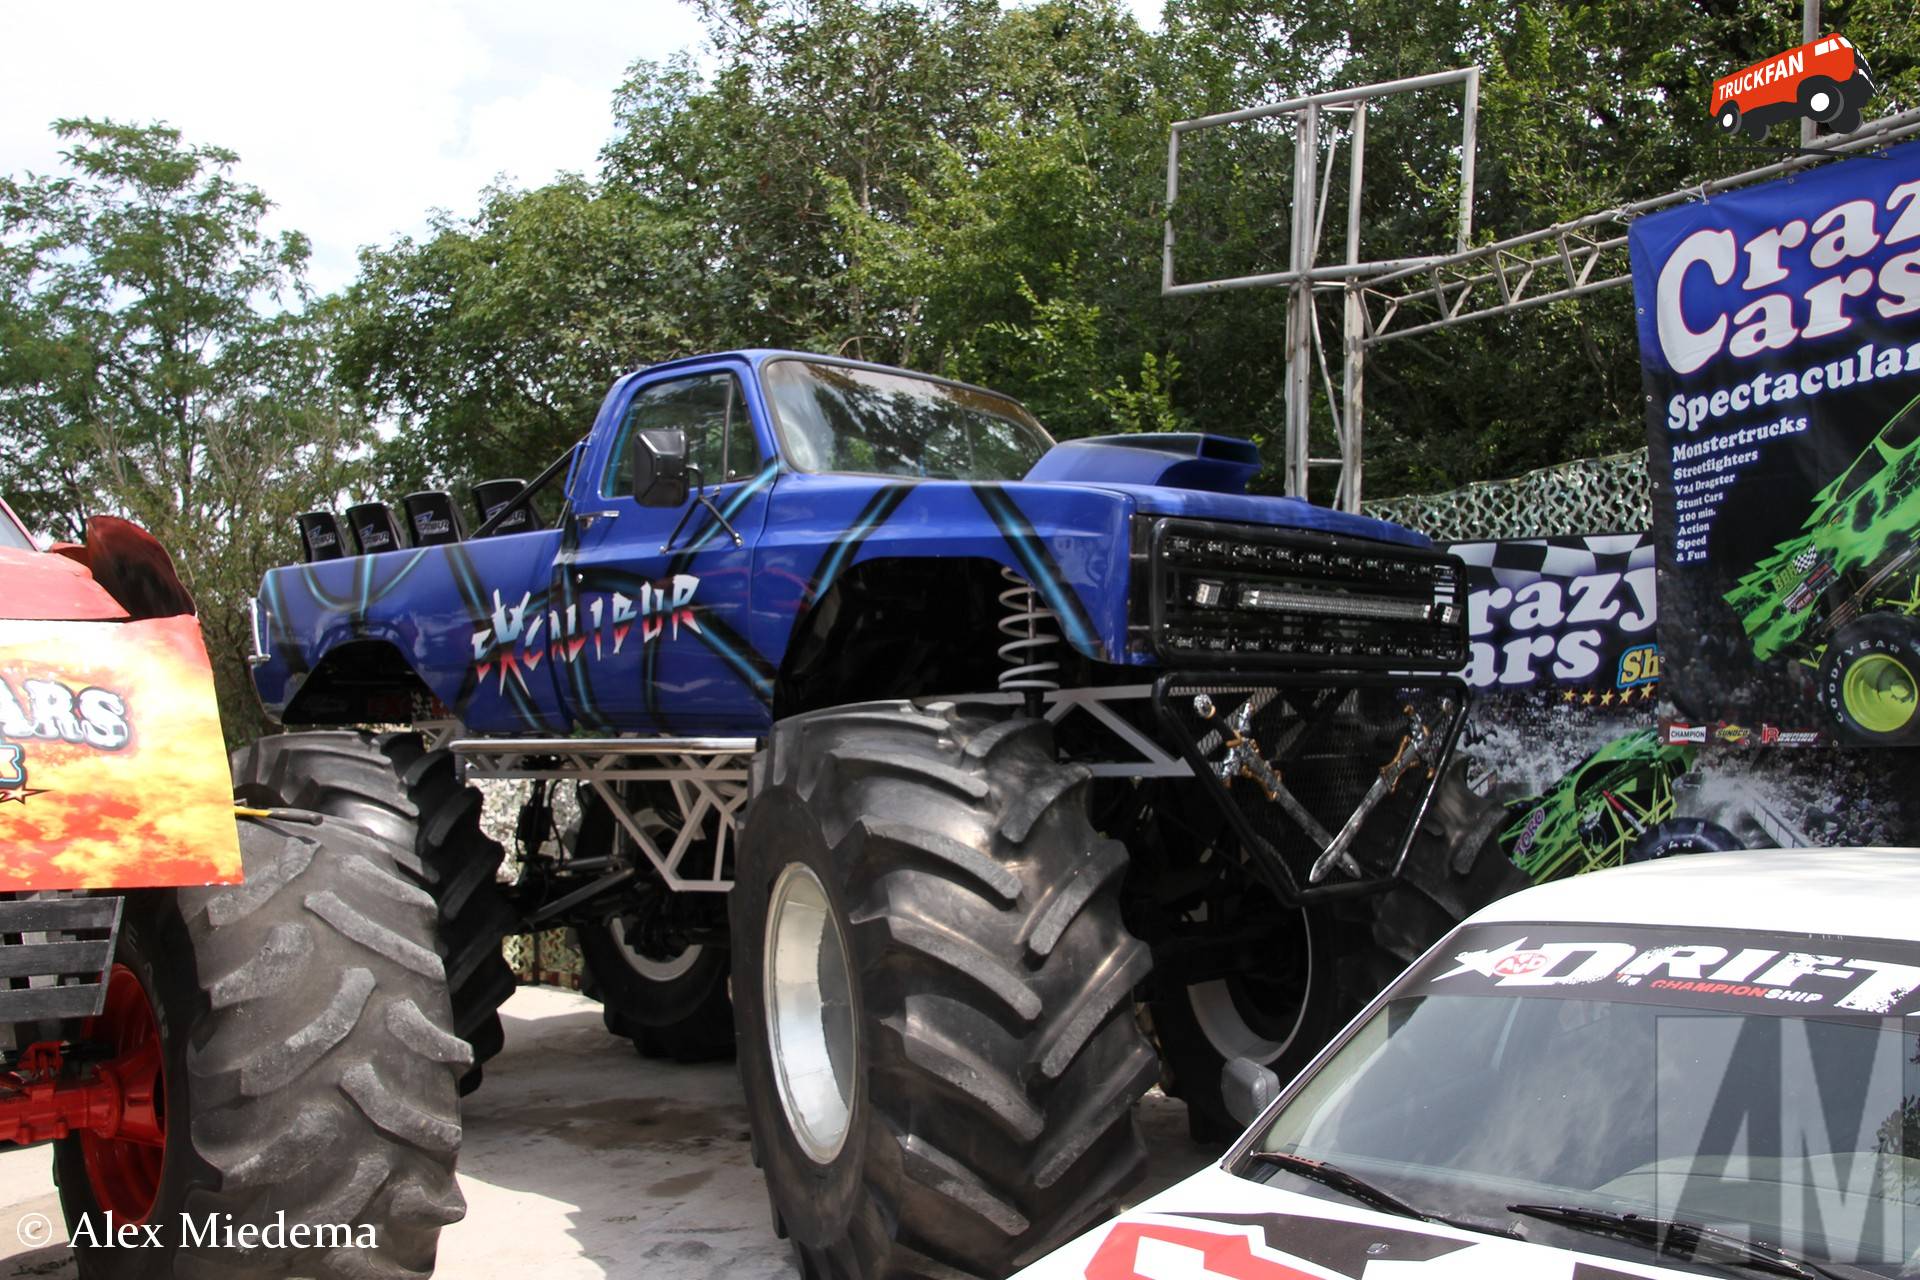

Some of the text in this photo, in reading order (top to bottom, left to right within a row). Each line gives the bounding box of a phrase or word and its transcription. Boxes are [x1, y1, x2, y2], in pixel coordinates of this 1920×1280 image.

[1672, 416, 1808, 462] Monstertrucks
[1674, 450, 1759, 480] Streetfighters
[1675, 473, 1735, 495] V24 Dragster
[1676, 492, 1723, 510] Stunt Cars
[1679, 507, 1716, 523] 100 min.
[1678, 523, 1710, 536] Action
[1676, 535, 1707, 550] Speed
[1676, 550, 1707, 562] & Fun
[1828, 640, 1901, 723] GOODYEAR
[1670, 730, 1705, 739] CHAMPION
[1495, 942, 1920, 1014] DRIFT
[1650, 979, 1823, 1003] CHAMPIONSHIP
